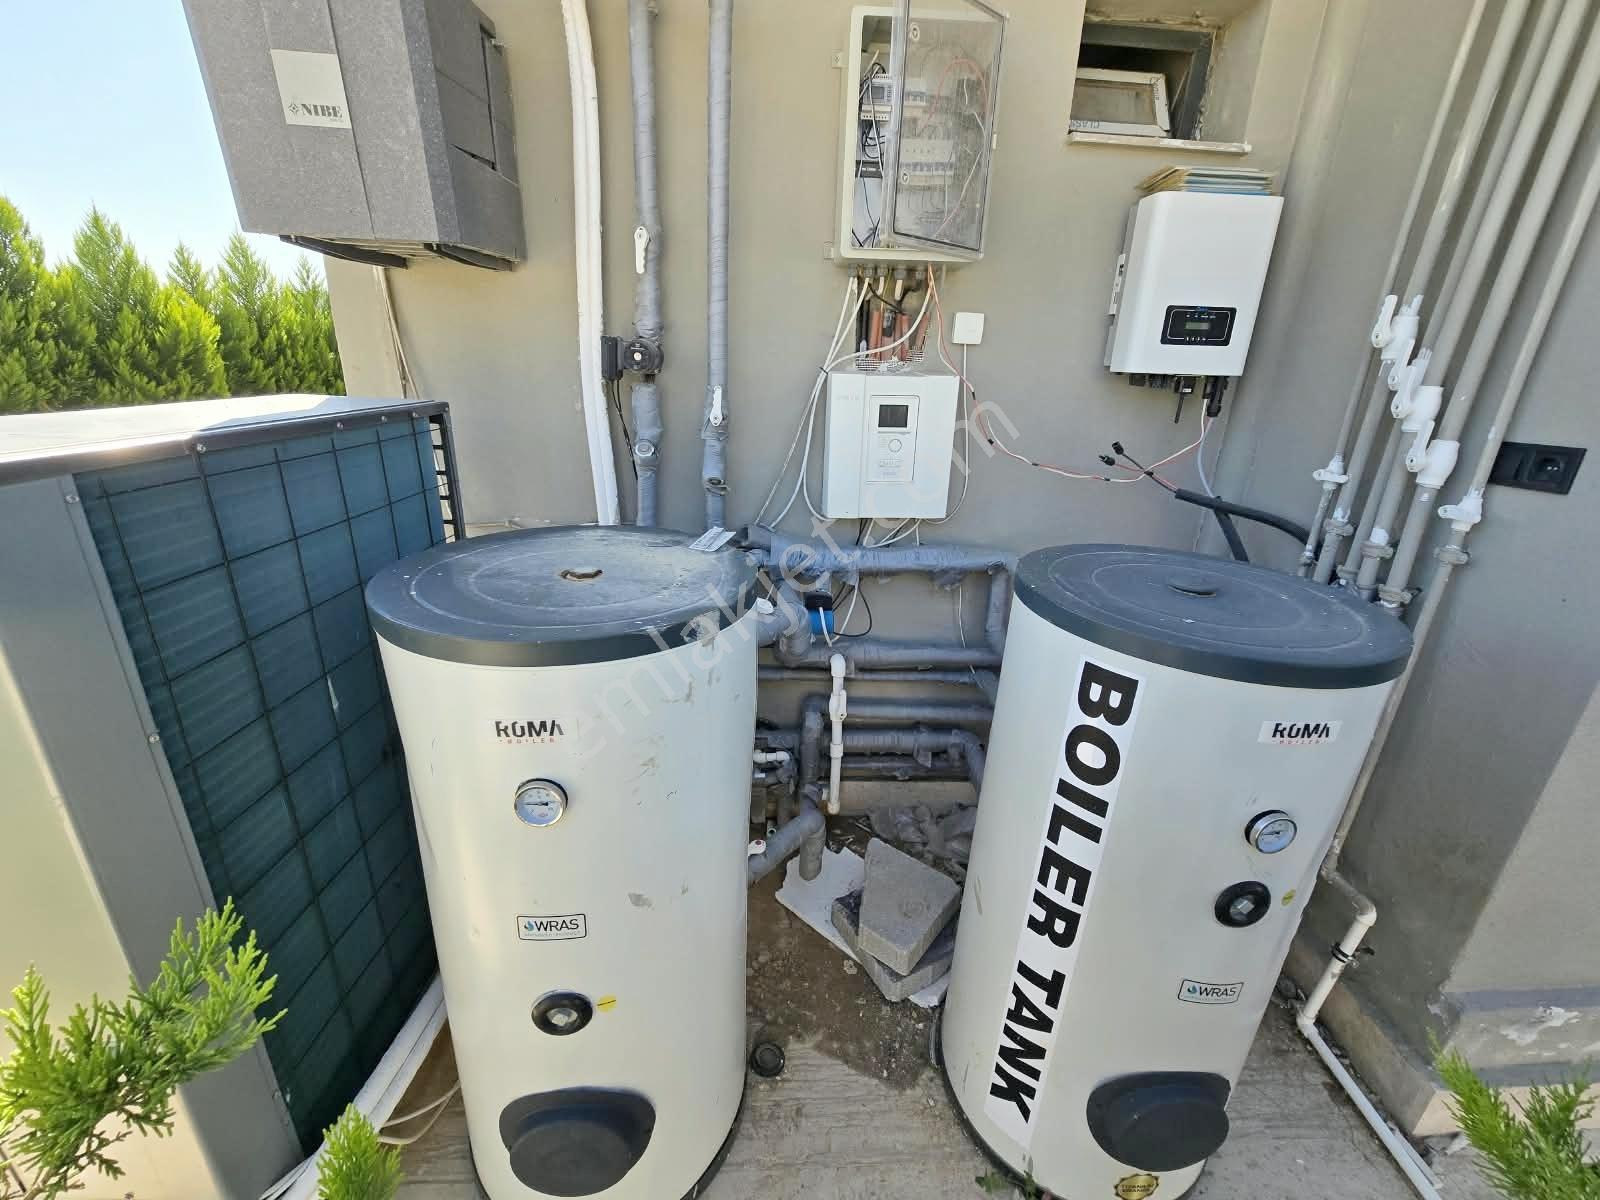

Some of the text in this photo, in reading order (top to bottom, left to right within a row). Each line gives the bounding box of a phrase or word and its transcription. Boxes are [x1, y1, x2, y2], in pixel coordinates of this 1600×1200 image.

[300, 103, 343, 118] NIBE
[494, 720, 565, 738] ROMA
[1271, 722, 1331, 739] ROMA
[989, 661, 1139, 1124] BOILER TANK
[534, 918, 580, 932] WRAS
[1199, 986, 1238, 997] WRAS
